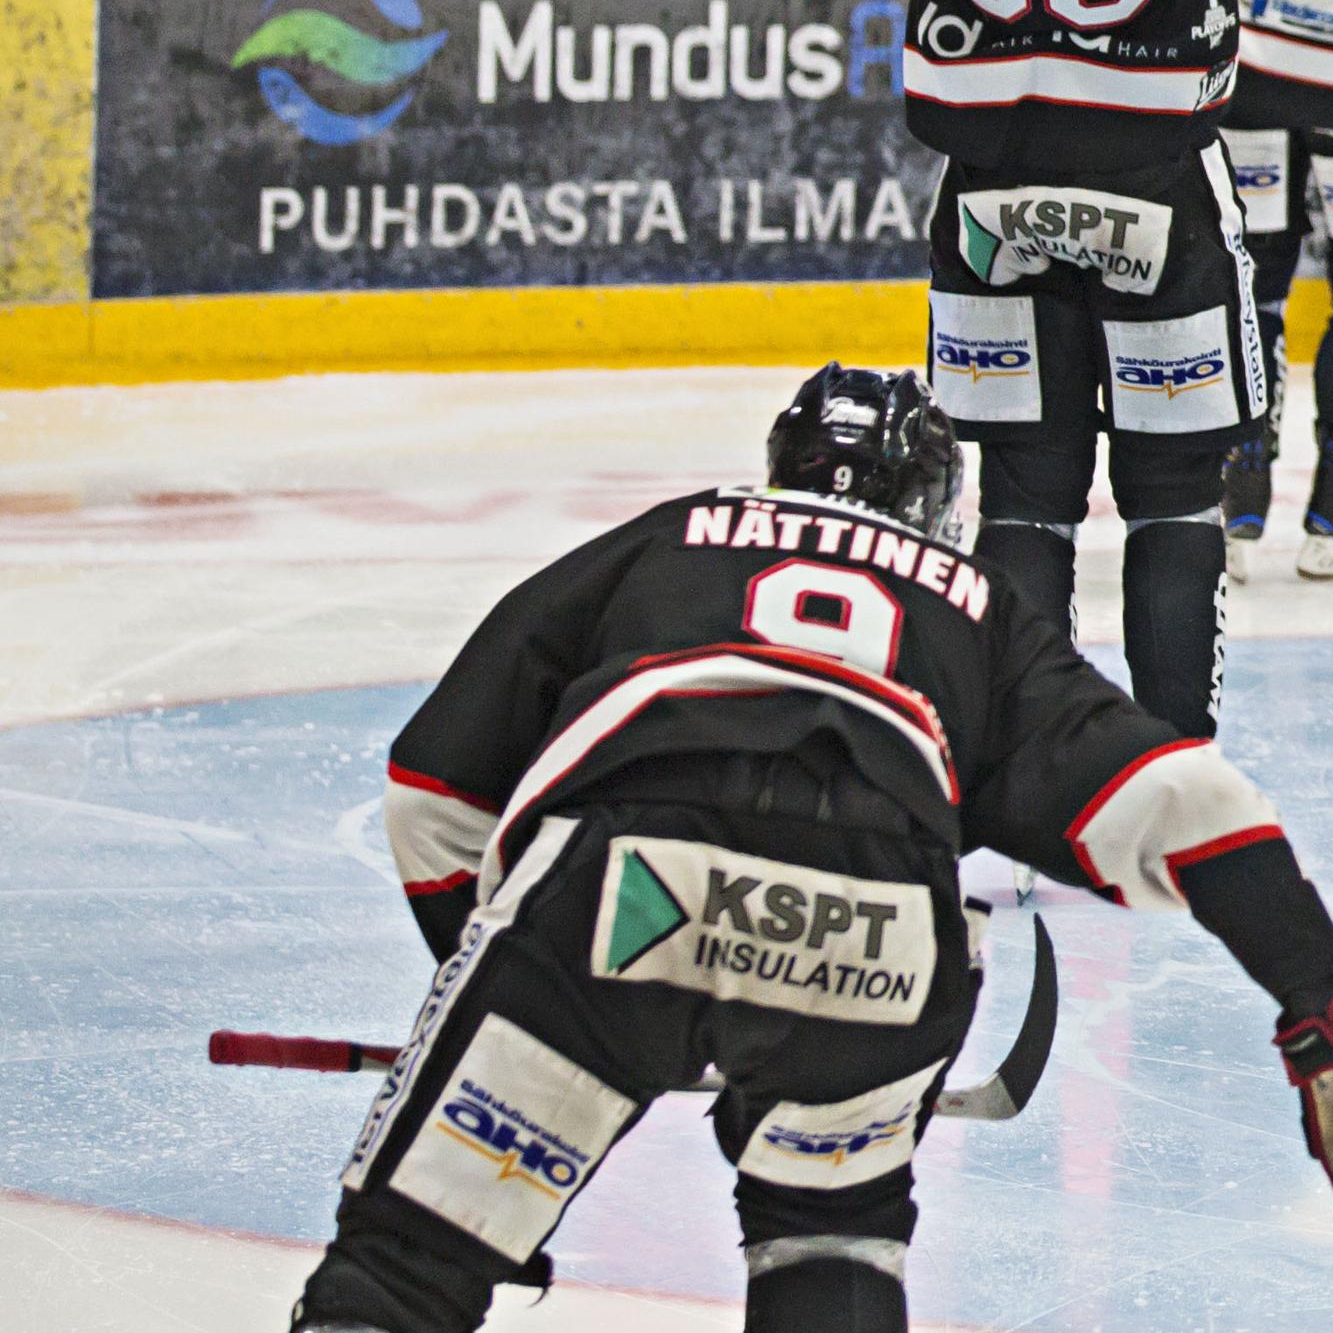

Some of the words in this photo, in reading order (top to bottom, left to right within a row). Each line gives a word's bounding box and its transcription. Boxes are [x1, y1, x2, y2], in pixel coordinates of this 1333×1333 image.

[258, 178, 687, 254] PUHDASTA
[719, 175, 932, 245] ILMA
[999, 199, 1140, 249] KSPT
[1011, 235, 1152, 281] INULATION
[833, 465, 853, 492] 9
[684, 498, 991, 623] NÄTTINEN
[740, 556, 905, 679] 9
[703, 866, 898, 961] KSPT
[694, 931, 916, 1004] INSULATION
